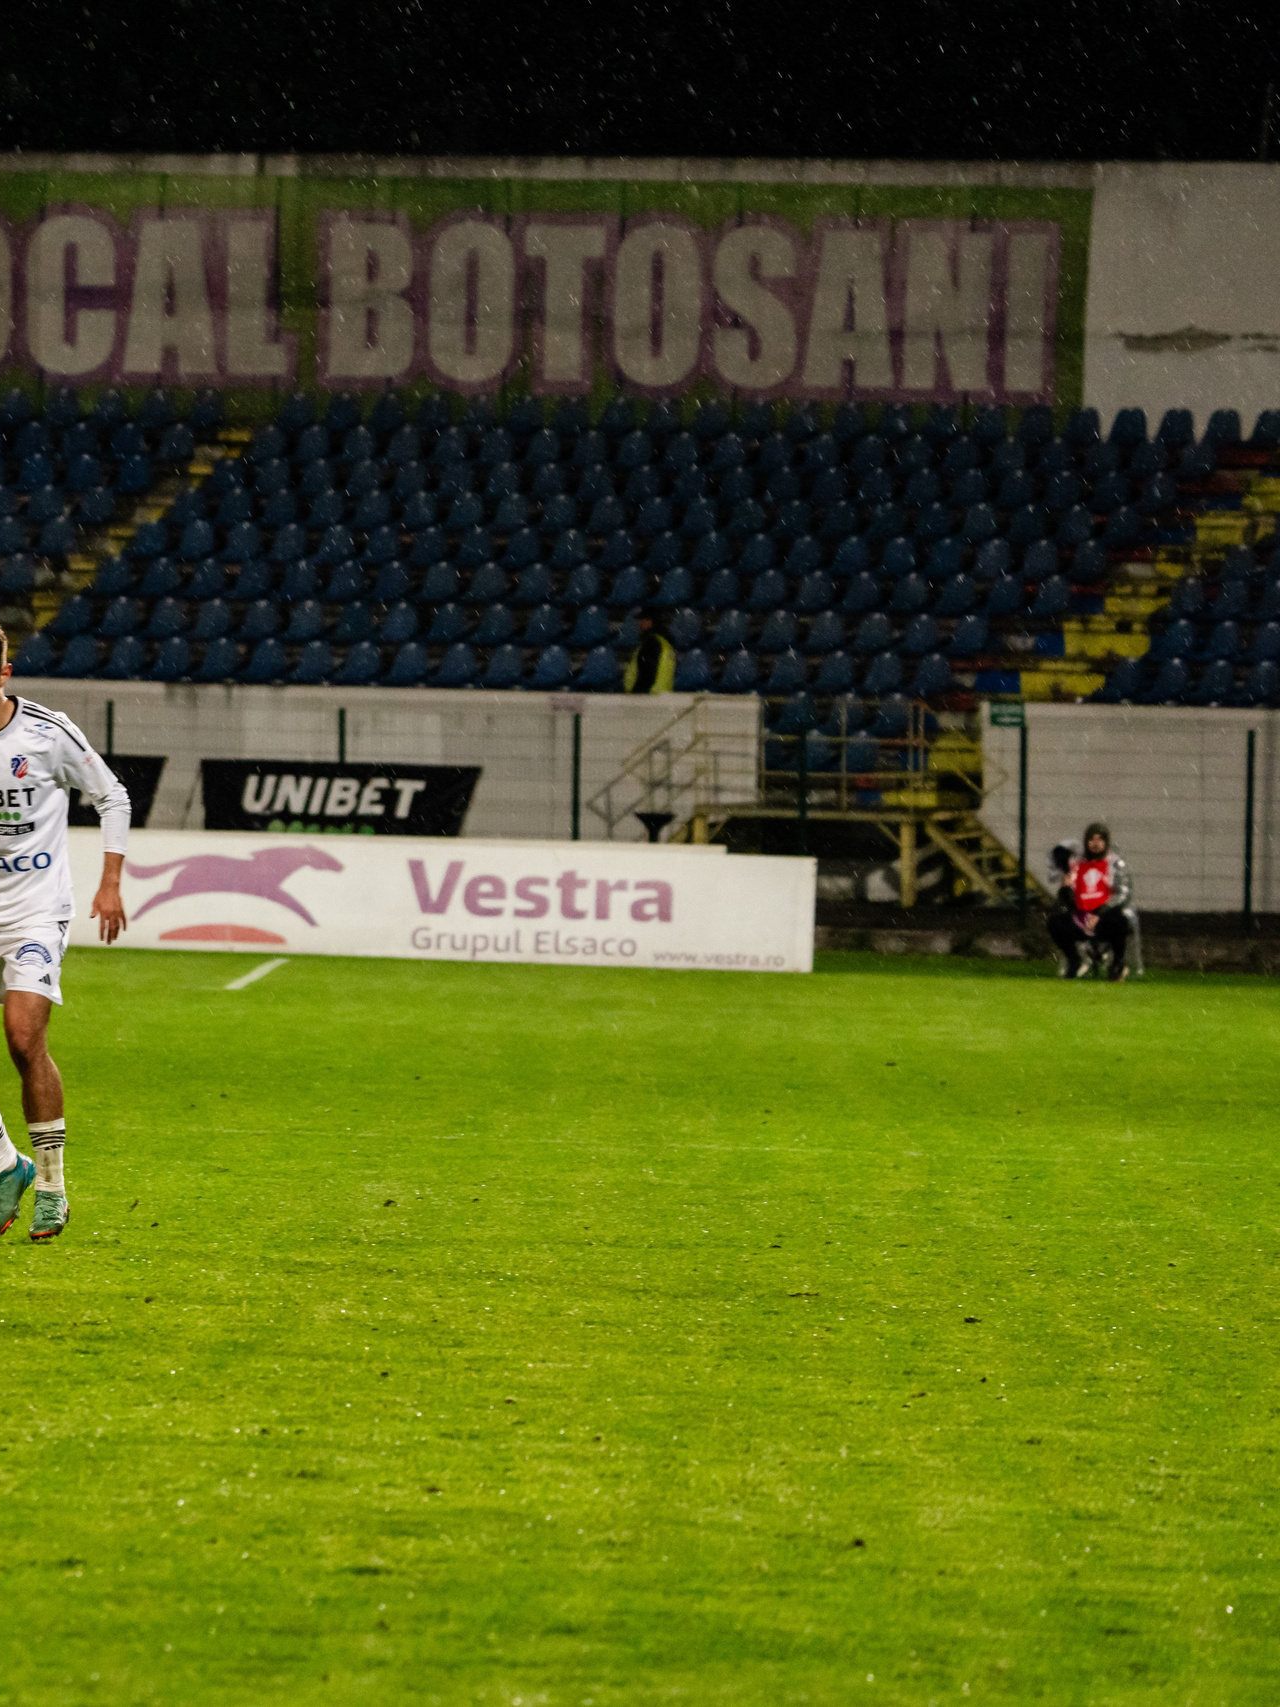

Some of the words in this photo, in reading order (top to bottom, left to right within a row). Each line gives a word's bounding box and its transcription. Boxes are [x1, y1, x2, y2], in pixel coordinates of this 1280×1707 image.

[325, 216, 1048, 393] BOTOSANI
[241, 773, 426, 819] UNIBET
[407, 858, 673, 923] Vestra
[411, 926, 521, 961] Grupul
[534, 930, 637, 957] Elsaco
